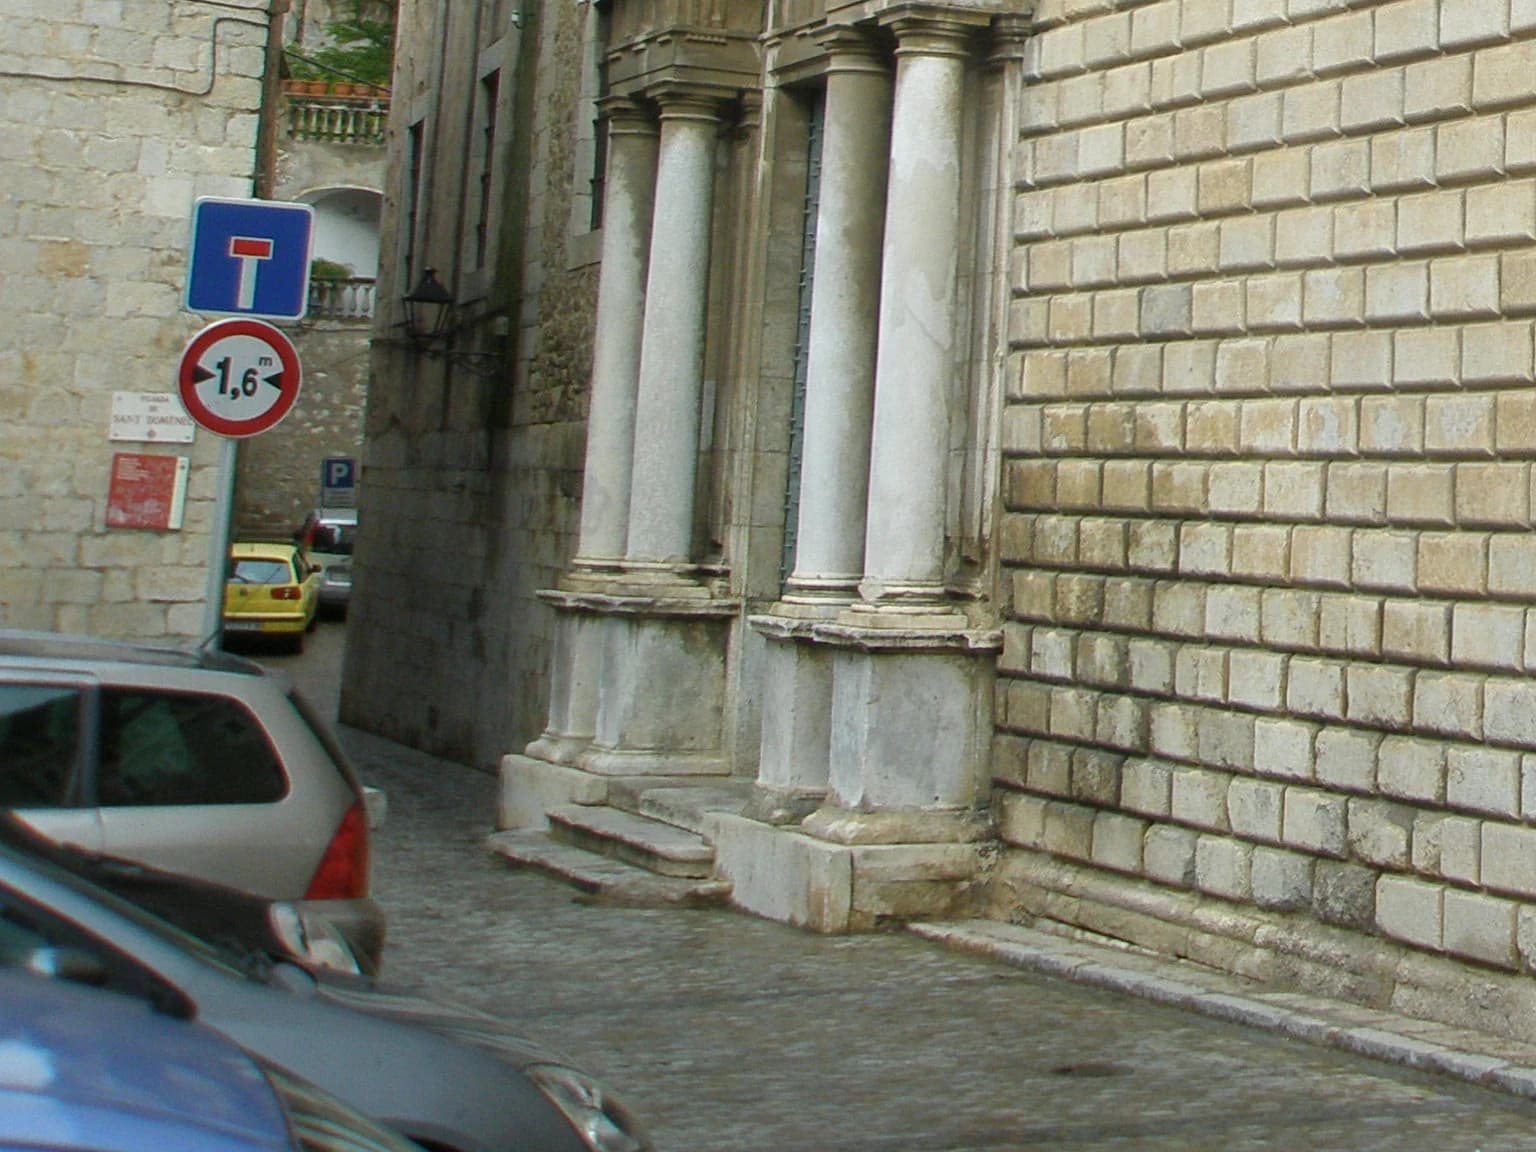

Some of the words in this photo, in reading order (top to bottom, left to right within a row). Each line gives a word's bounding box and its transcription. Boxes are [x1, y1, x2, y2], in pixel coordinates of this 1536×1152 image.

[217, 356, 258, 400] 1,6
[259, 357, 273, 366] m
[332, 463, 349, 485] P
